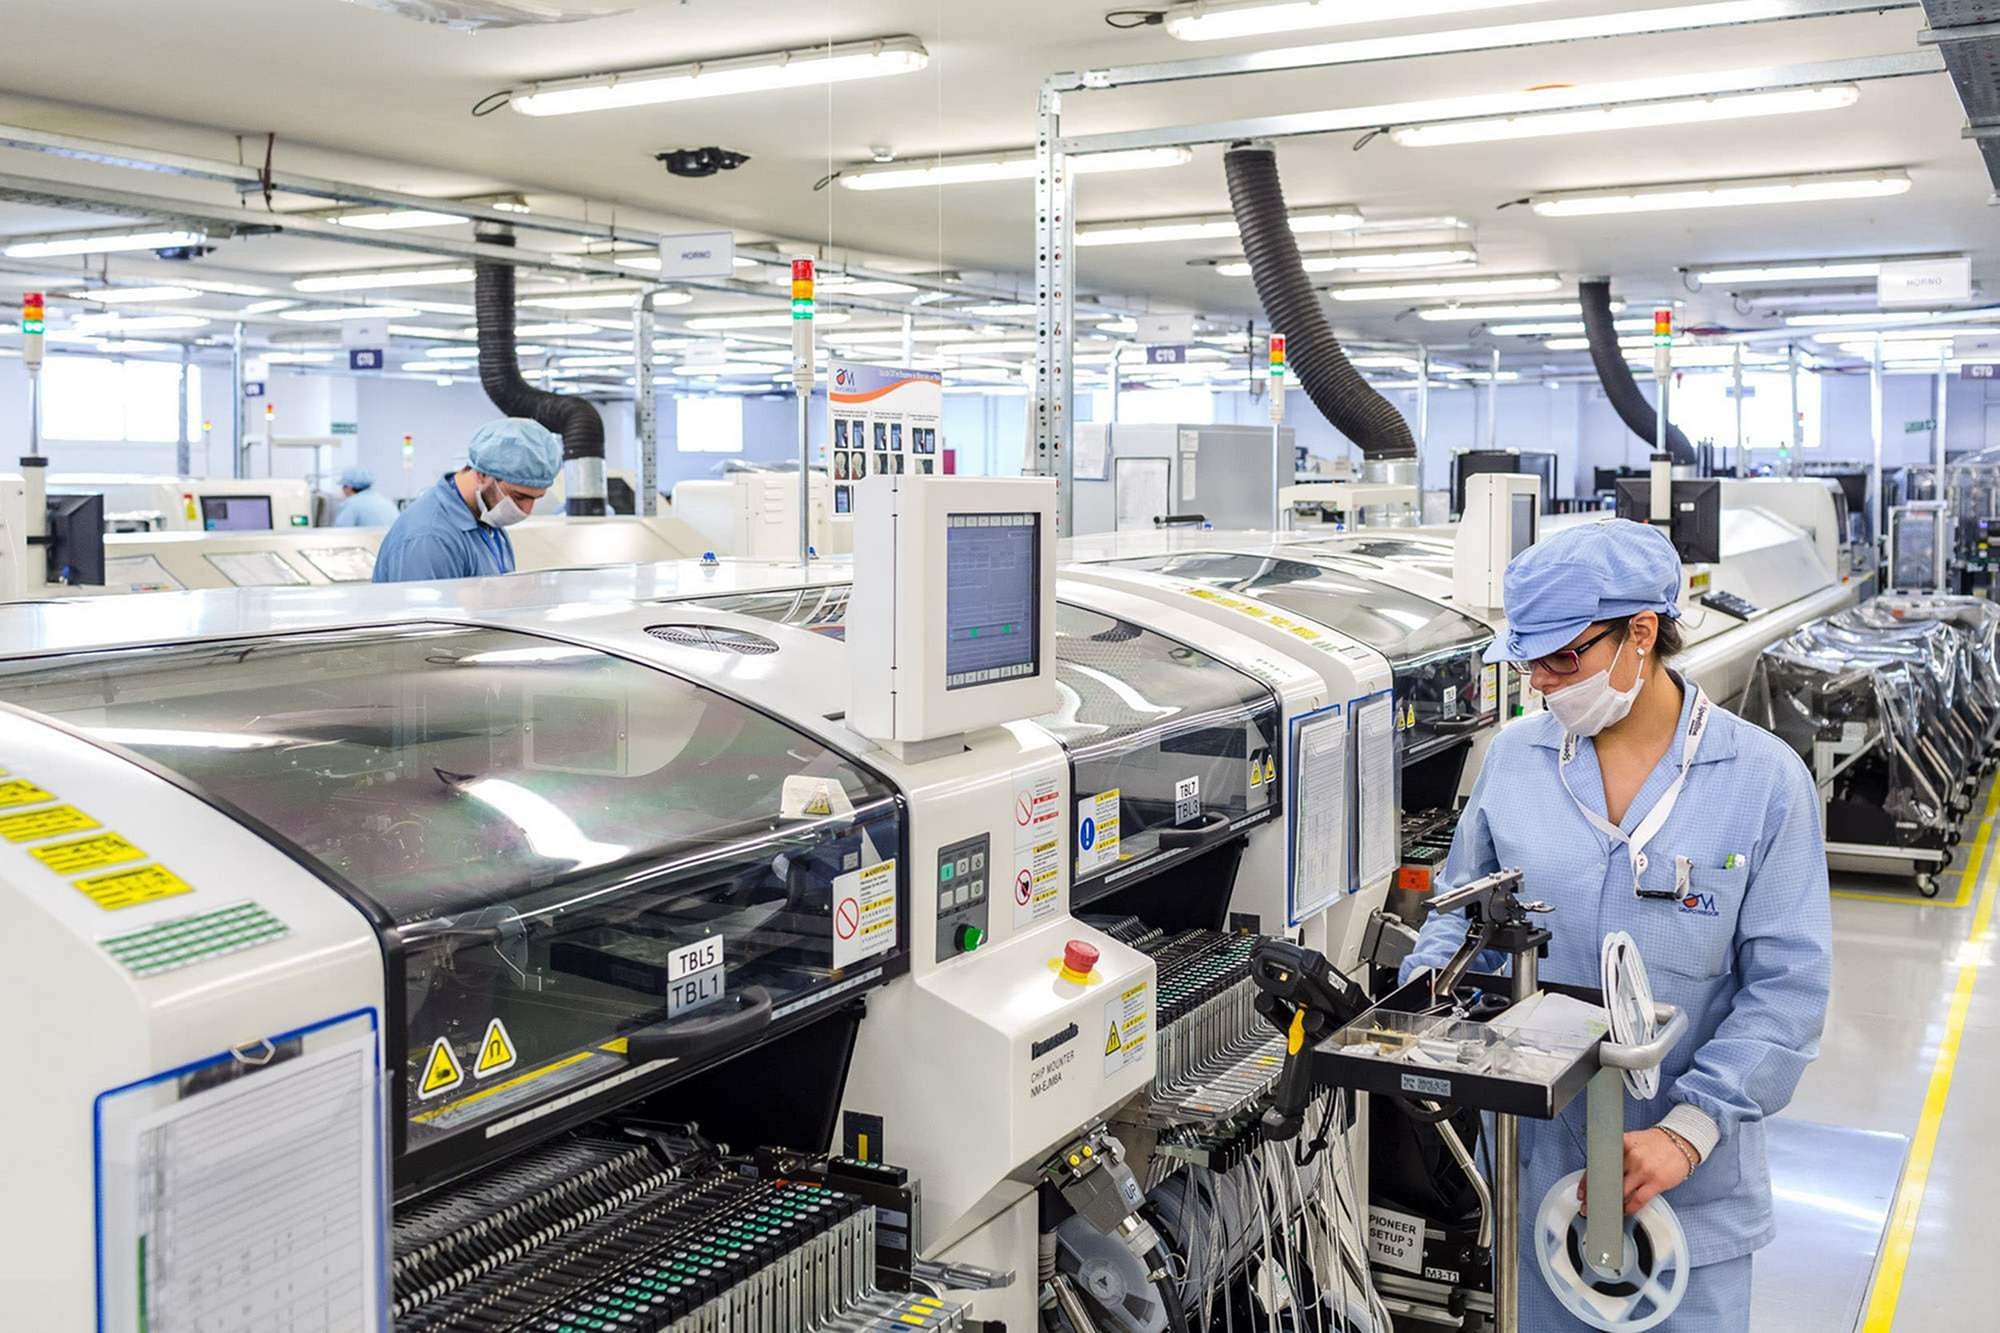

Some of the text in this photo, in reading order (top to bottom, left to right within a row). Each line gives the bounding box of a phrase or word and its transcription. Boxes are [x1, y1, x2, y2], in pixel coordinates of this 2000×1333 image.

[1180, 781, 1195, 798] TBL7
[1178, 799, 1198, 820] TBL3
[679, 944, 715, 974] TBL5
[1030, 1049, 1074, 1084] CHIP MOUNTER
[1125, 1183, 1136, 1200] UP
[1369, 1214, 1416, 1235] PIONEER
[1369, 1227, 1414, 1247] SETUP 3
[1377, 1242, 1404, 1258] TBL9
